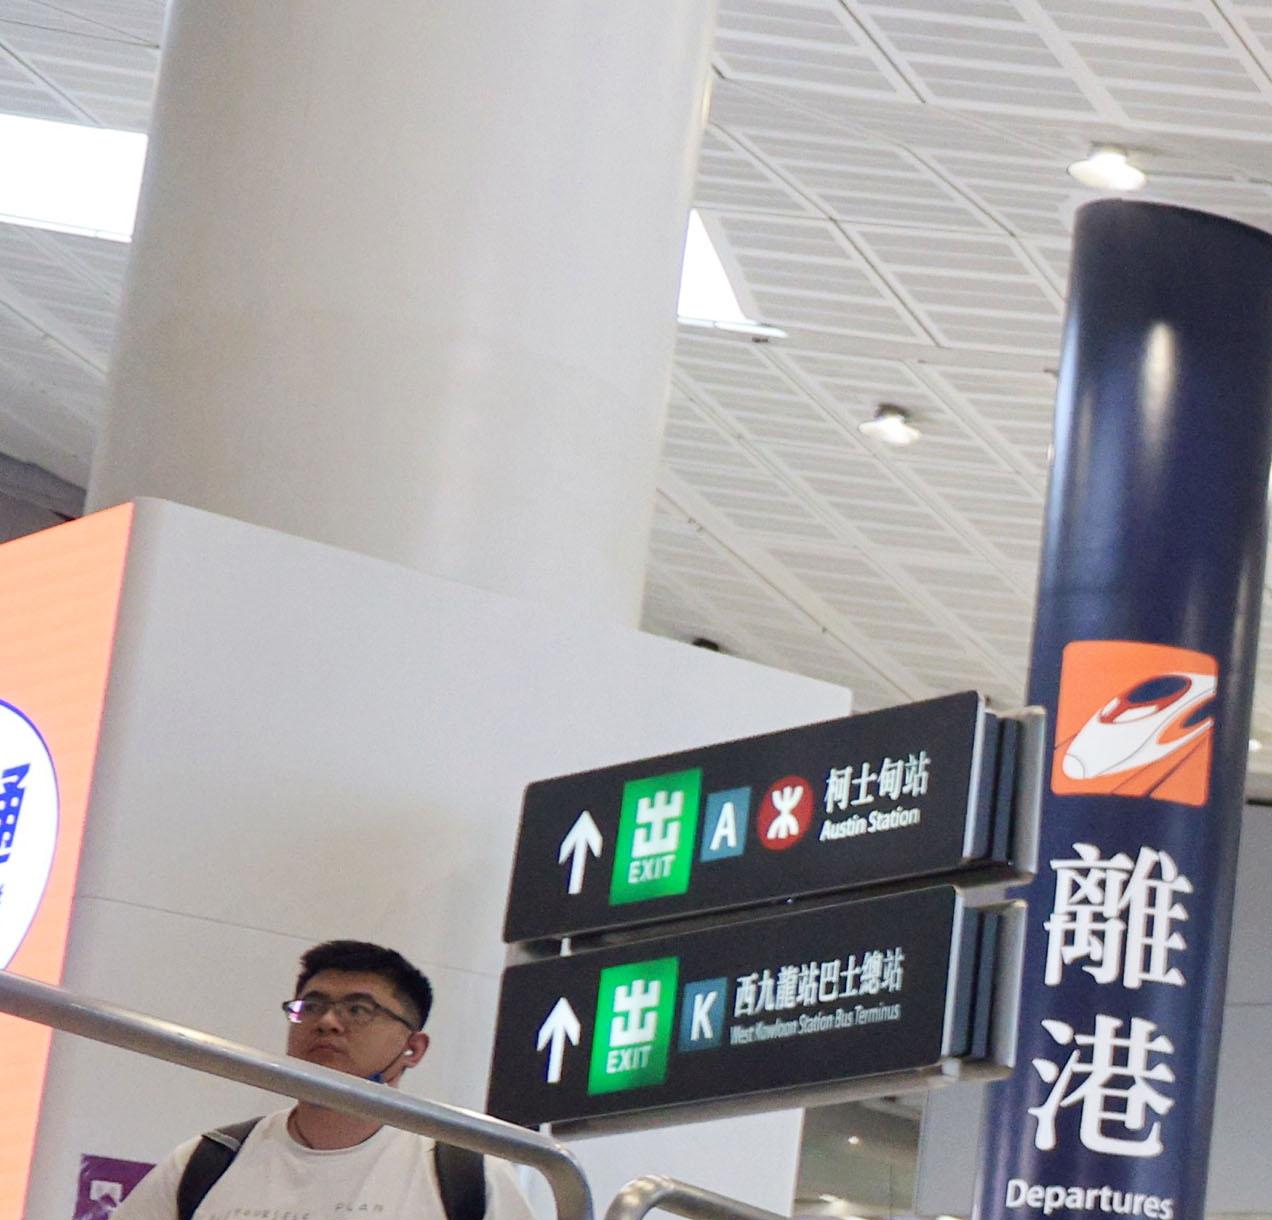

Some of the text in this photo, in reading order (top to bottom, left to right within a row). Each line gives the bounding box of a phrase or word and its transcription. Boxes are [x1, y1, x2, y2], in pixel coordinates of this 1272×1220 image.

[824, 750, 931, 813] 柯士甸站
[631, 790, 685, 857] 出
[709, 801, 738, 851] A
[819, 805, 921, 841] Austin Station
[628, 855, 674, 883] EXIT
[733, 947, 905, 1018] 西九龍站巴士總站
[1027, 842, 1194, 1156] 離港
[609, 978, 661, 1047] 出
[689, 991, 719, 1041] K
[730, 1002, 901, 1045] West Kowloon Station Bus Terminus
[606, 1045, 653, 1073] EXIT
[1005, 1178, 1174, 1220] Departures
